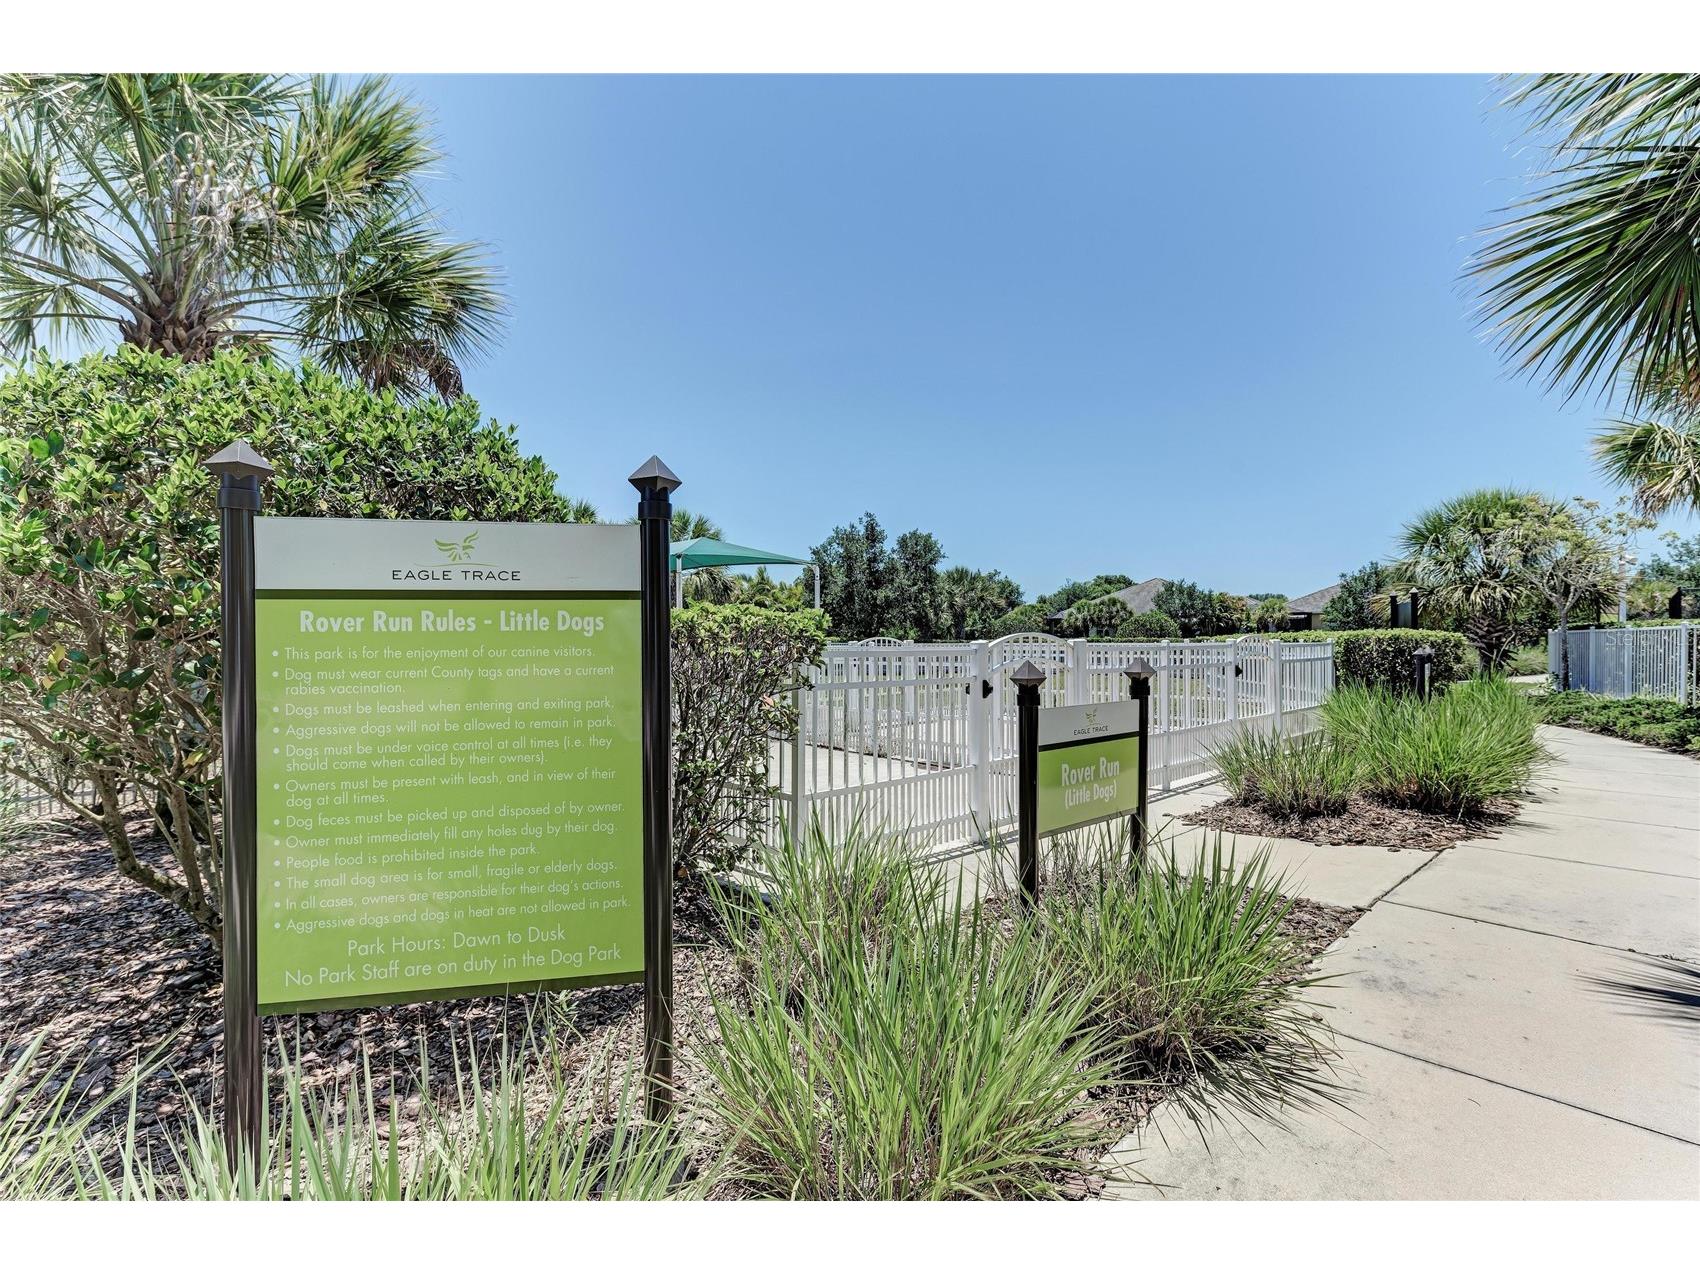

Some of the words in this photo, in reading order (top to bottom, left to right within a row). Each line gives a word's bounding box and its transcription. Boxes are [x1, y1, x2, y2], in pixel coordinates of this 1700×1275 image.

[392, 569, 452, 581] EAGLE
[461, 570, 521, 581] TRACE
[299, 611, 365, 632] Rover
[373, 611, 413, 631] Run
[421, 610, 476, 631] Rules
[499, 609, 549, 631] Little
[557, 610, 604, 636] Dogs
[284, 647, 309, 659] This
[314, 646, 342, 663] park
[348, 646, 357, 658] is
[362, 646, 378, 658] for
[383, 646, 401, 658] the
[406, 645, 468, 662] enjoyment
[472, 645, 483, 657] of
[488, 649, 505, 657] our
[511, 644, 549, 657] canine
[554, 644, 596, 656] visitors.
[284, 668, 312, 683] Dog
[316, 668, 345, 679] must
[349, 670, 381, 679] wear
[385, 667, 427, 678] current
[431, 666, 474, 681] County
[478, 666, 502, 680] tags
[506, 664, 529, 676] and
[532, 663, 560, 676] have
[564, 667, 571, 675] a
[575, 664, 615, 675] current
[285, 682, 326, 695] rabies
[329, 680, 406, 694] vaccination.
[285, 703, 319, 719] Dogs
[323, 703, 352, 714] must
[356, 701, 372, 713] be
[376, 700, 424, 713] leashed
[428, 699, 460, 712] when
[465, 698, 512, 714] entering
[517, 697, 539, 709] and
[543, 696, 581, 712] exiting
[585, 695, 615, 712] park.
[285, 722, 357, 739] Aggressive
[360, 721, 391, 737] dogs
[395, 720, 417, 732] will
[421, 720, 440, 732] not
[444, 719, 459, 731] be
[463, 717, 511, 730] allowed
[514, 718, 525, 729] to
[529, 715, 568, 728] remain
[573, 715, 583, 727] in
[587, 714, 616, 731] park.
[1092, 725, 1109, 733] TRACE
[285, 744, 319, 759] Dogs
[324, 743, 352, 755] must
[356, 741, 372, 754] be
[377, 740, 411, 753] under
[416, 739, 448, 752] voice
[452, 737, 492, 750] control
[497, 738, 508, 749] at
[511, 736, 526, 748] all
[530, 735, 559, 748] times
[563, 734, 585, 751] (i.e.
[589, 733, 612, 749] they
[285, 780, 336, 791] Owners
[340, 777, 368, 789] must
[372, 775, 388, 788] be
[392, 775, 436, 791] present
[439, 772, 464, 785] with
[468, 771, 501, 785] leash,
[506, 769, 529, 782] and
[533, 769, 543, 781] in
[547, 768, 573, 781] view
[576, 767, 588, 779] of
[591, 766, 616, 779] their
[1061, 764, 1095, 786] Rover
[1100, 757, 1120, 778] Run
[285, 794, 312, 810] dog
[316, 794, 330, 805] at
[333, 792, 350, 804] all
[353, 791, 390, 803] times.
[1065, 786, 1090, 809] (Little
[1093, 780, 1117, 802] Dogs)
[286, 815, 313, 830] Dog
[318, 813, 351, 825] feces
[355, 812, 383, 823] must
[387, 809, 403, 822] be
[407, 807, 447, 825] picked
[452, 810, 467, 822] up
[471, 805, 494, 818] and
[498, 802, 550, 819] disposed
[554, 801, 565, 814] of
[569, 800, 583, 816] by
[587, 803, 624, 812] owner.
[286, 835, 330, 847] Owner
[335, 833, 362, 844] must
[367, 827, 440, 843] immediately
[444, 826, 457, 839] fill
[461, 829, 483, 841] any
[487, 824, 517, 836] holes
[520, 822, 542, 838] dug
[546, 821, 561, 837] by
[564, 819, 588, 832] their
[592, 819, 618, 834] dog.
[286, 854, 329, 871] People
[334, 852, 362, 865] food
[368, 851, 377, 864] is
[382, 847, 444, 867] prohibited
[449, 845, 484, 859] inside
[488, 844, 506, 856] the
[510, 842, 541, 859] park.
[286, 876, 309, 889] The
[314, 873, 346, 887] small
[350, 872, 375, 888] dog
[380, 874, 408, 883] area
[414, 869, 423, 881] is
[427, 868, 443, 880] for
[447, 865, 481, 879] small,
[486, 862, 524, 879] fragile
[527, 865, 540, 874] or
[543, 859, 582, 875] elderly
[586, 858, 617, 873] dogs.
[286, 915, 355, 934] Aggressive
[359, 913, 389, 928] dogs
[393, 909, 416, 923] and
[420, 908, 449, 924] dogs
[454, 906, 464, 918] in
[468, 905, 493, 917] heat
[496, 906, 516, 915] are
[520, 902, 537, 914] not
[541, 897, 585, 912] allowed
[589, 897, 599, 909] in
[603, 894, 631, 912] park.
[347, 937, 385, 956] Park
[391, 937, 446, 952] Hours:
[452, 932, 501, 947] Dawn
[505, 929, 522, 944] to
[527, 923, 566, 942] Dusk
[285, 970, 313, 986] No
[319, 965, 356, 983] Park
[361, 961, 400, 980] Staff
[404, 964, 432, 976] are
[437, 962, 457, 974] on
[463, 955, 497, 974] duty
[503, 952, 516, 968] in
[522, 950, 545, 967] the
[550, 948, 583, 967] Dog
[588, 943, 621, 961] Park
